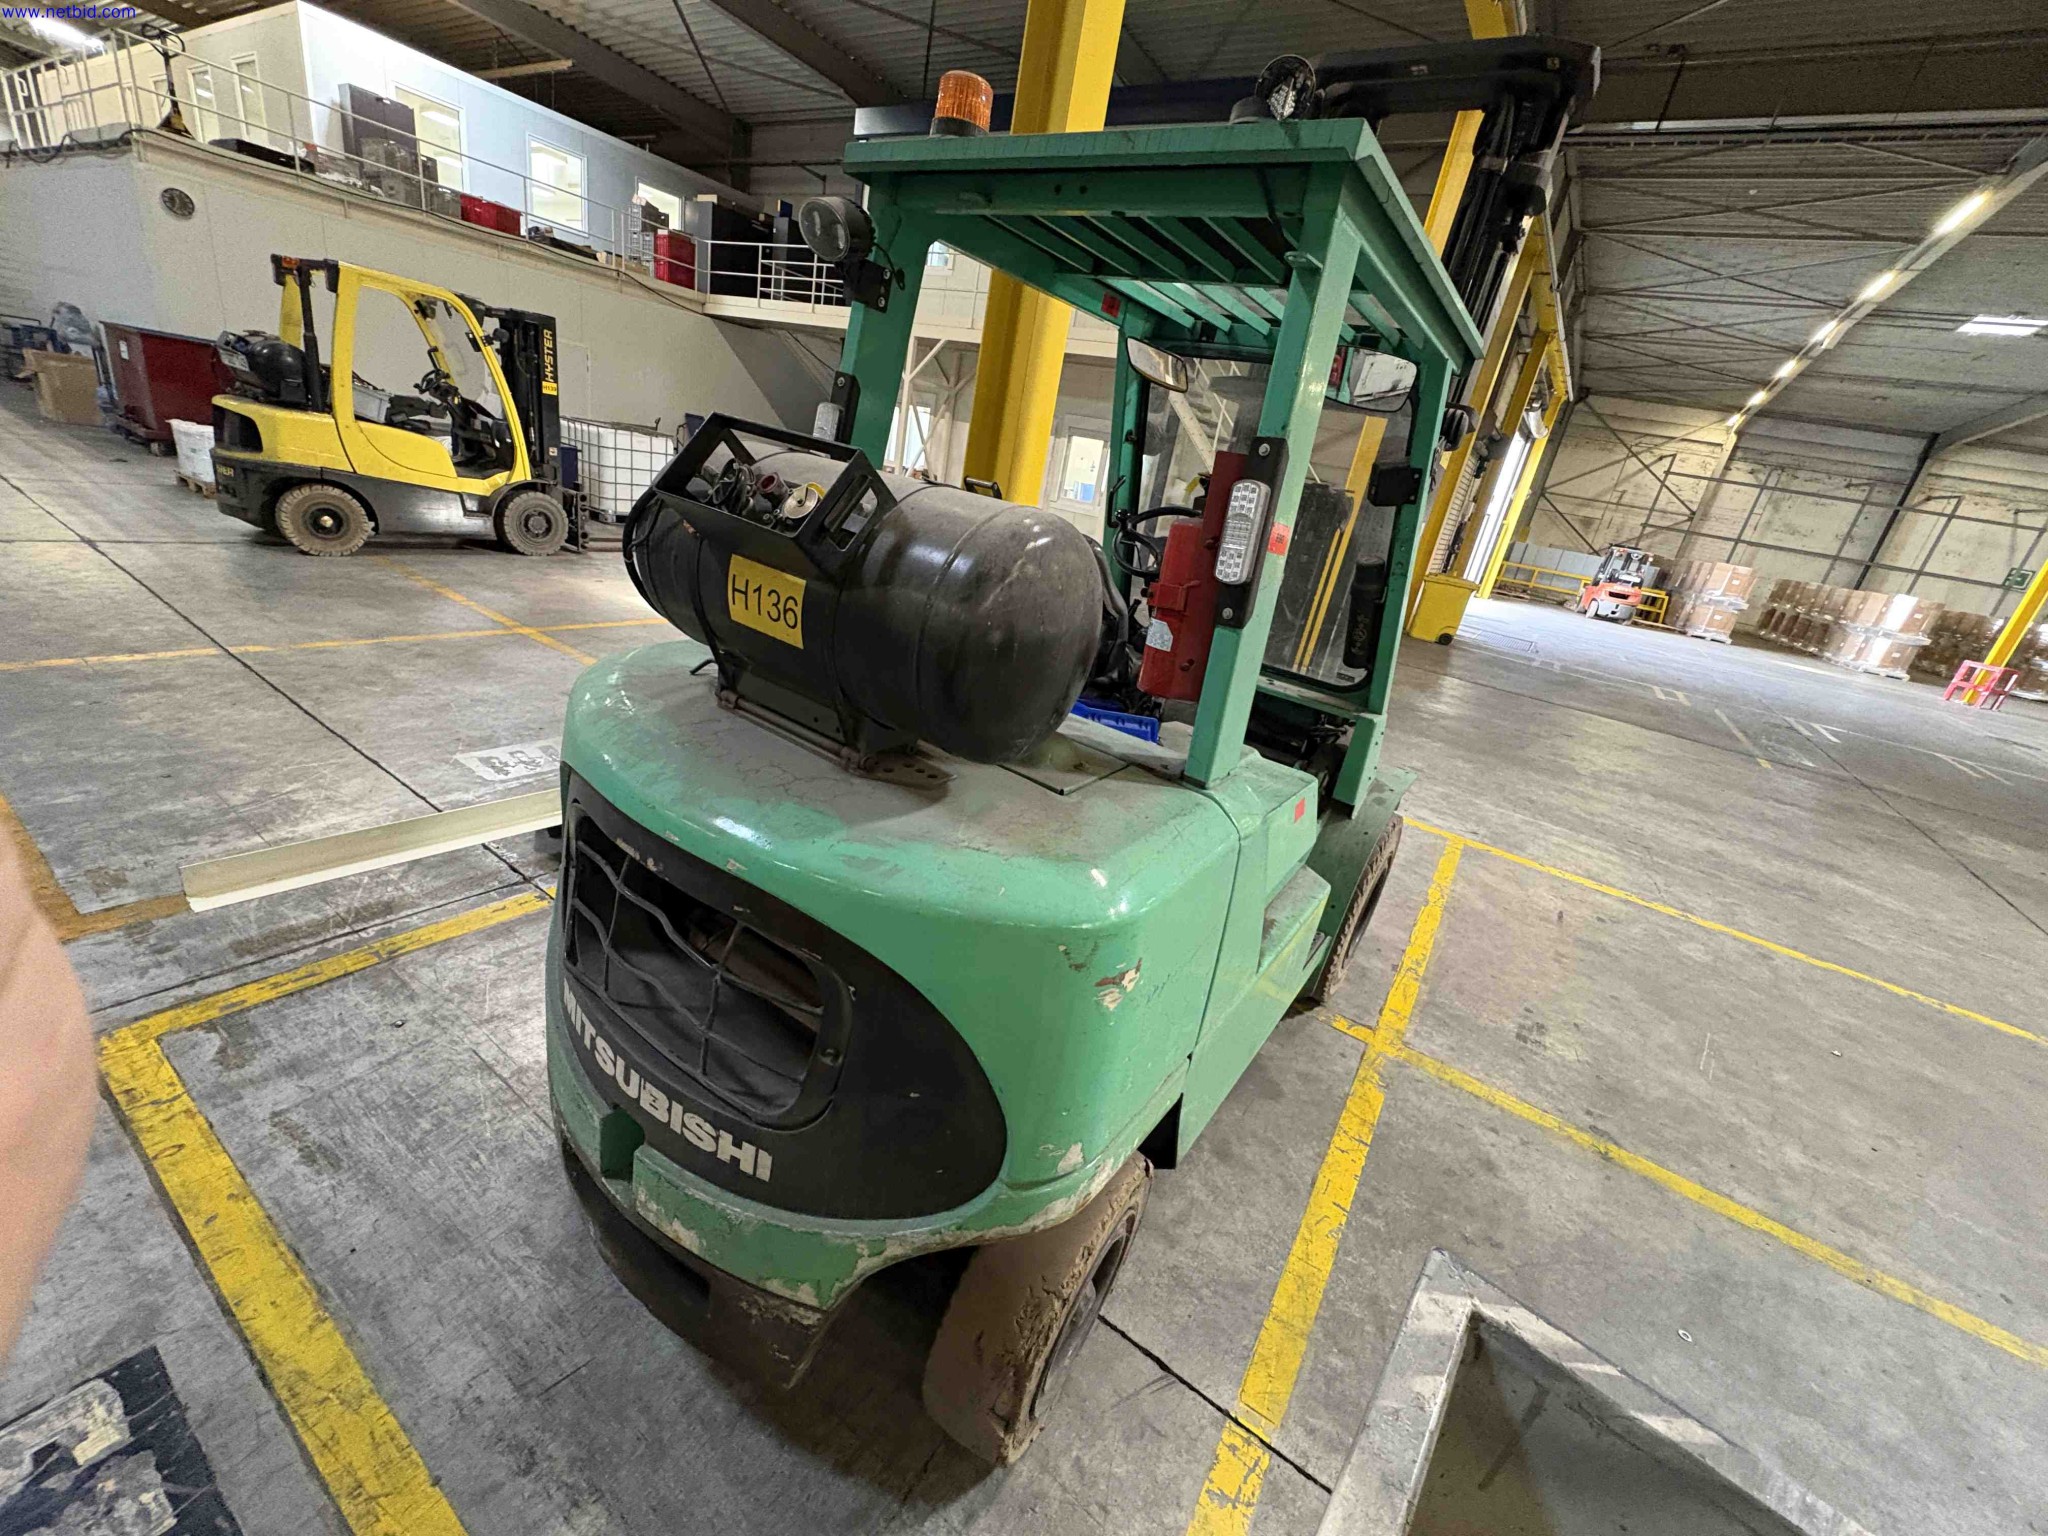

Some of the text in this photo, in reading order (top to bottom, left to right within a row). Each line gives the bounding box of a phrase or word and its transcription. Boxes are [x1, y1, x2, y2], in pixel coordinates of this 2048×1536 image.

[543, 329, 555, 382] HYSTER
[731, 573, 798, 630] H136
[563, 977, 773, 1183] MITSUBISHI
